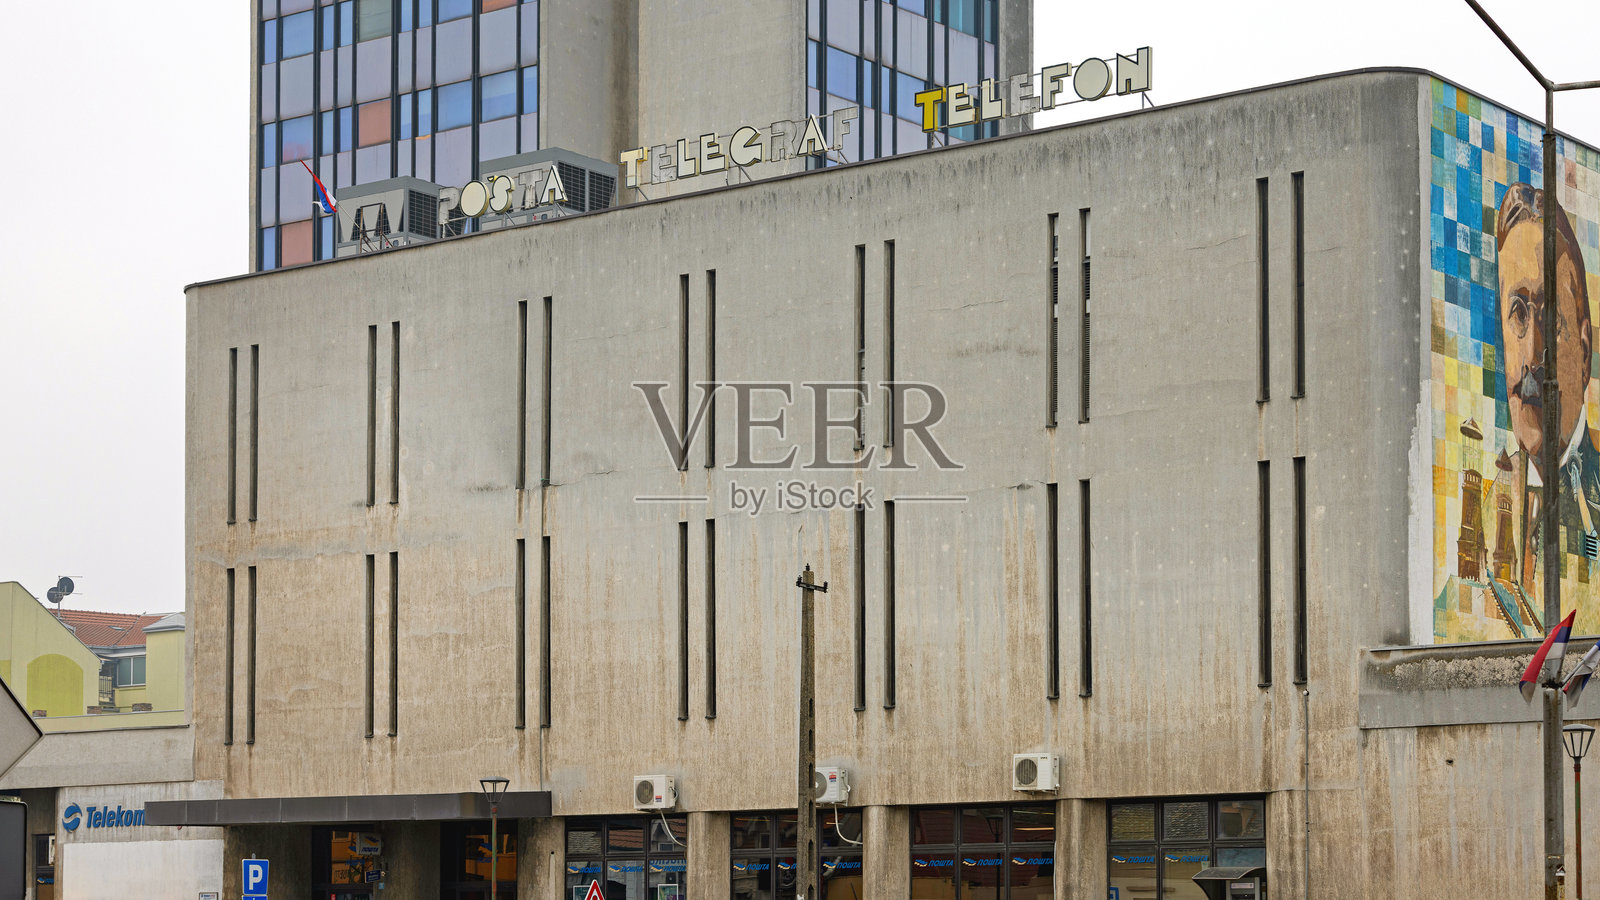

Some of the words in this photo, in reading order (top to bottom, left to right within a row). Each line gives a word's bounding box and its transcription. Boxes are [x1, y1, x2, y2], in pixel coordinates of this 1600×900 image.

[914, 46, 1152, 132] TELEFON
[620, 106, 859, 188] TELEGRAF
[86, 805, 145, 828] Telekom
[248, 864, 263, 890] P
